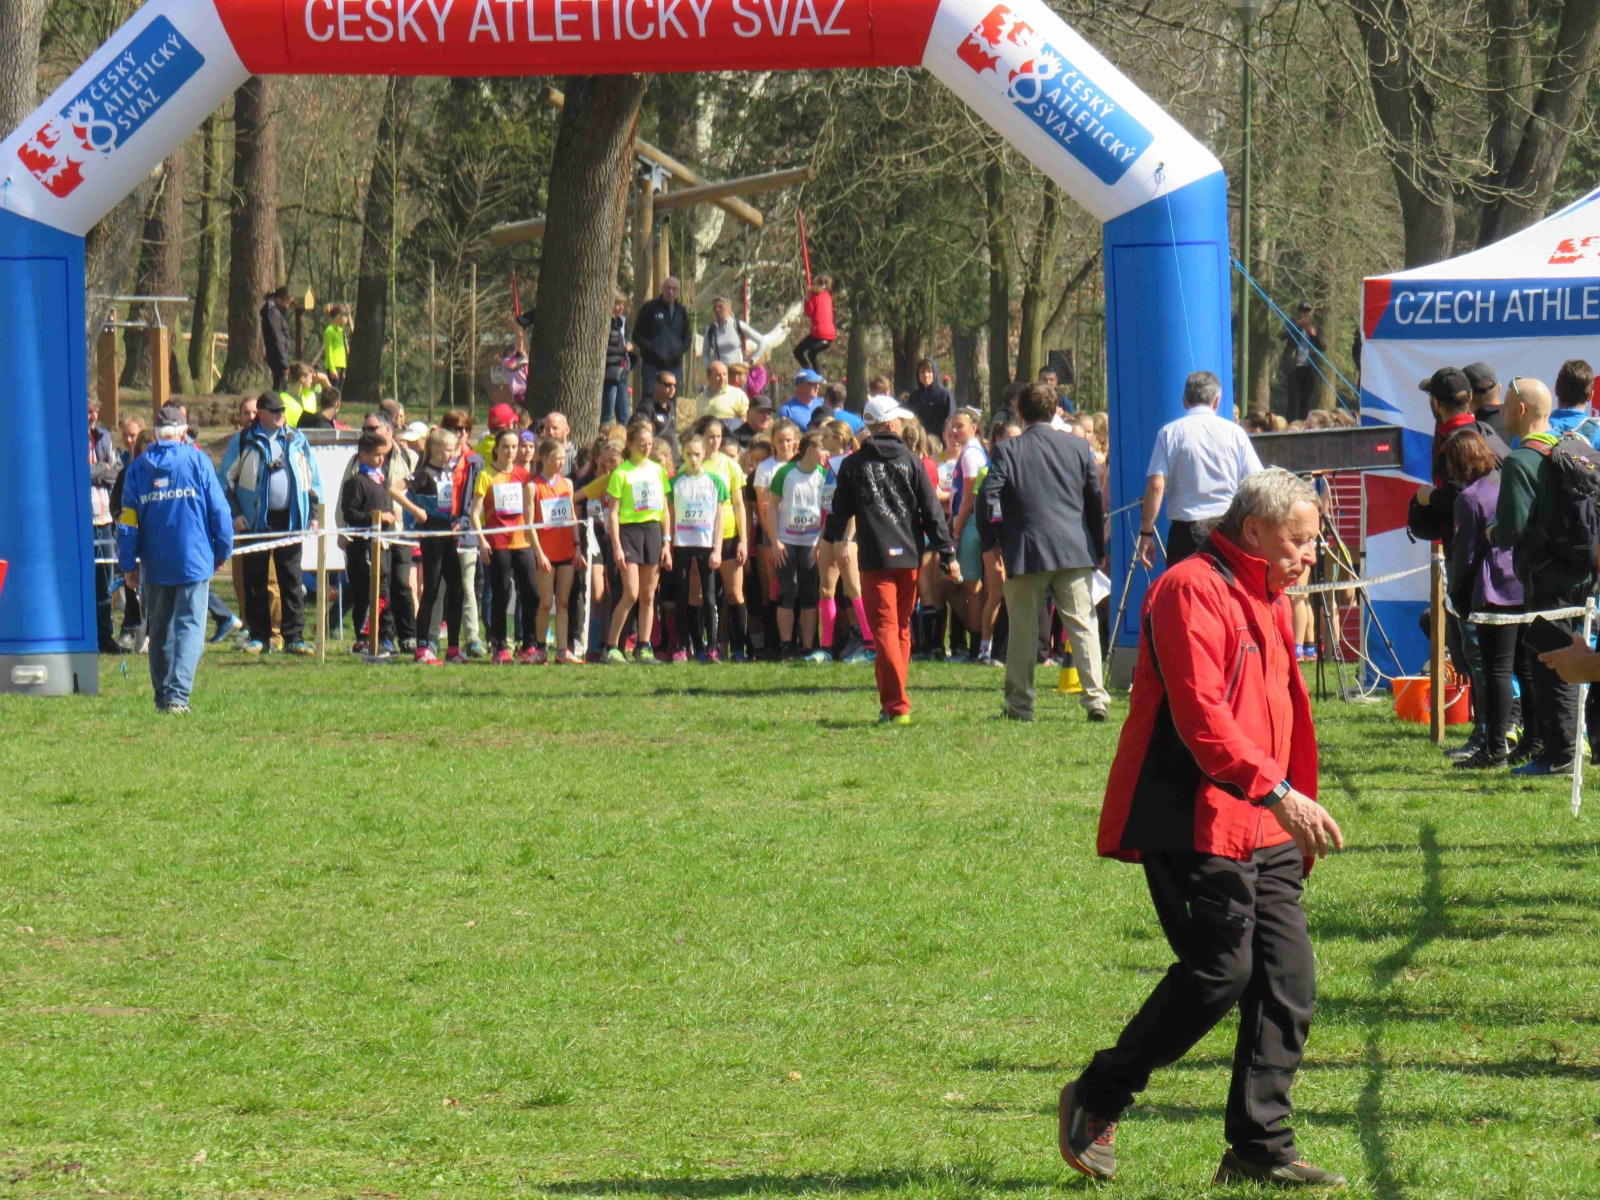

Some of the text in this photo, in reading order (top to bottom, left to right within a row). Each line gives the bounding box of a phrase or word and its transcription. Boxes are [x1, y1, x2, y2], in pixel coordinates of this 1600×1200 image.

[732, 0, 851, 39] SVAZ
[89, 50, 136, 101] ČESKÝ
[103, 32, 182, 118] ATLETICKÝ
[1061, 69, 1115, 118] ČESKÝ
[117, 87, 161, 130] SVAZ
[1033, 102, 1080, 145] SVAZ
[1045, 87, 1137, 163] ATLETICKÝ
[1394, 290, 1496, 325] CZECH
[551, 507, 567, 517] 510
[685, 510, 704, 518] 577
[794, 516, 813, 524] 604
